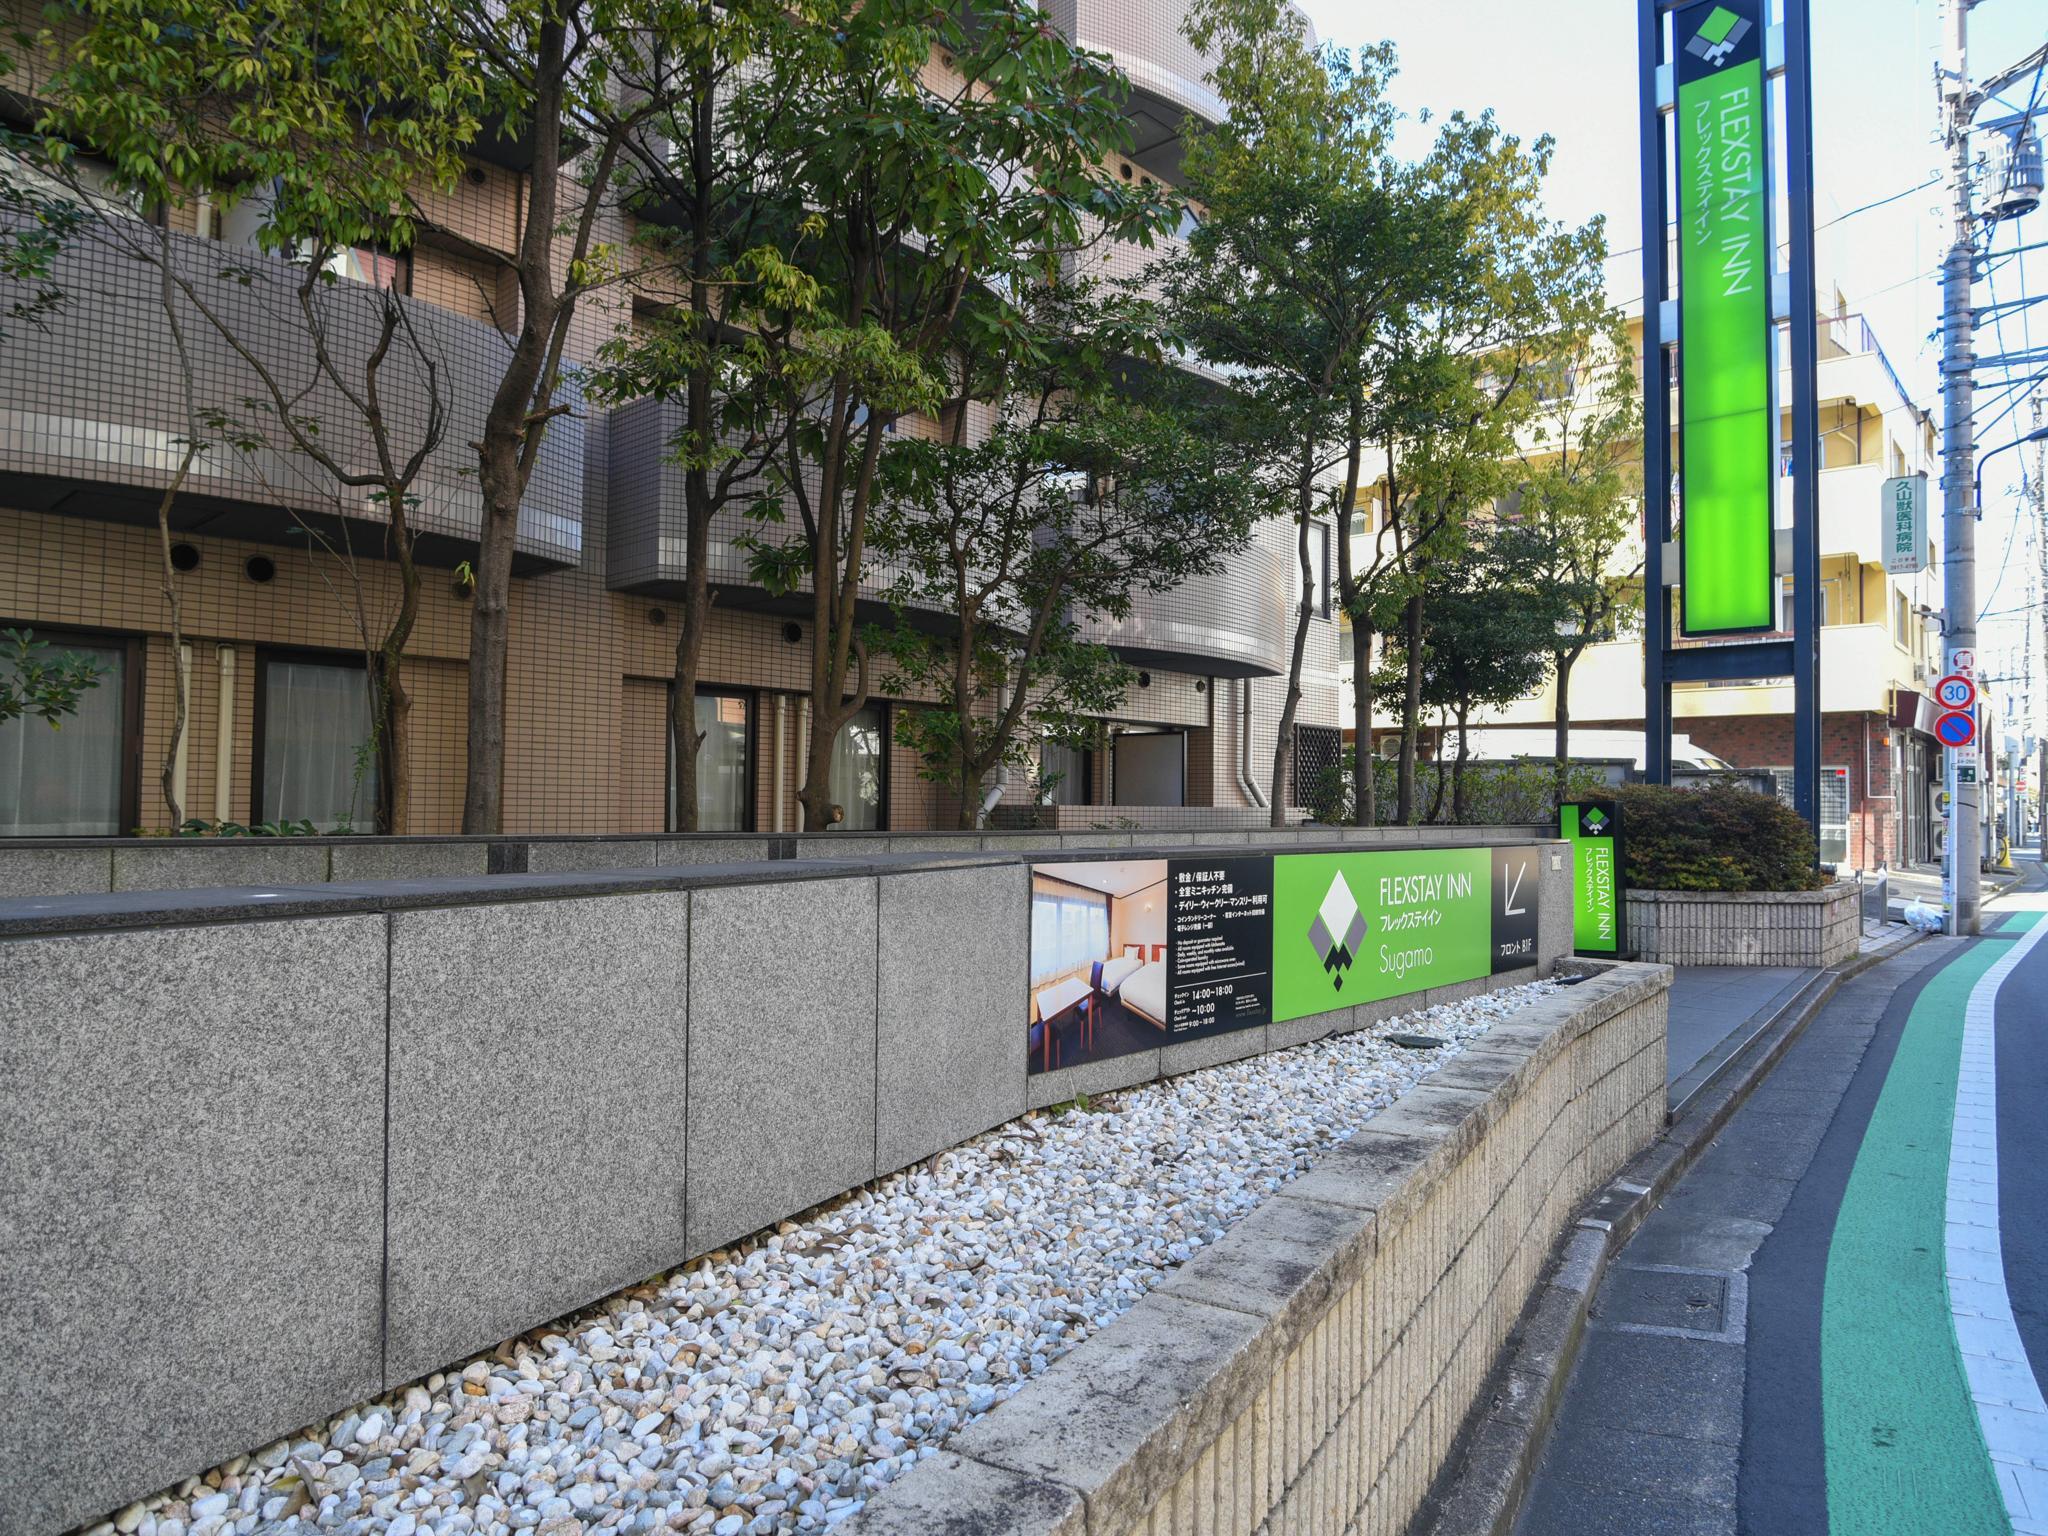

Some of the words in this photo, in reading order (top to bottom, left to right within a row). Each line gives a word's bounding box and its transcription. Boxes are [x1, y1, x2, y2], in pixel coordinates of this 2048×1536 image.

[1720, 87, 1752, 222] FLEXSTAY
[1721, 232, 1752, 297] INN
[1896, 481, 1912, 553] 久山獣医科病院
[1944, 685, 1967, 701] 30
[1380, 873, 1443, 906] FLEXSTAY
[1448, 872, 1472, 899] INN
[1596, 847, 1610, 908] FLEXSTAY
[1380, 908, 1442, 932] フレックステイイン
[1598, 913, 1612, 940] INN
[1380, 944, 1432, 979] Sugamo
[1501, 941, 1520, 957] フロント
